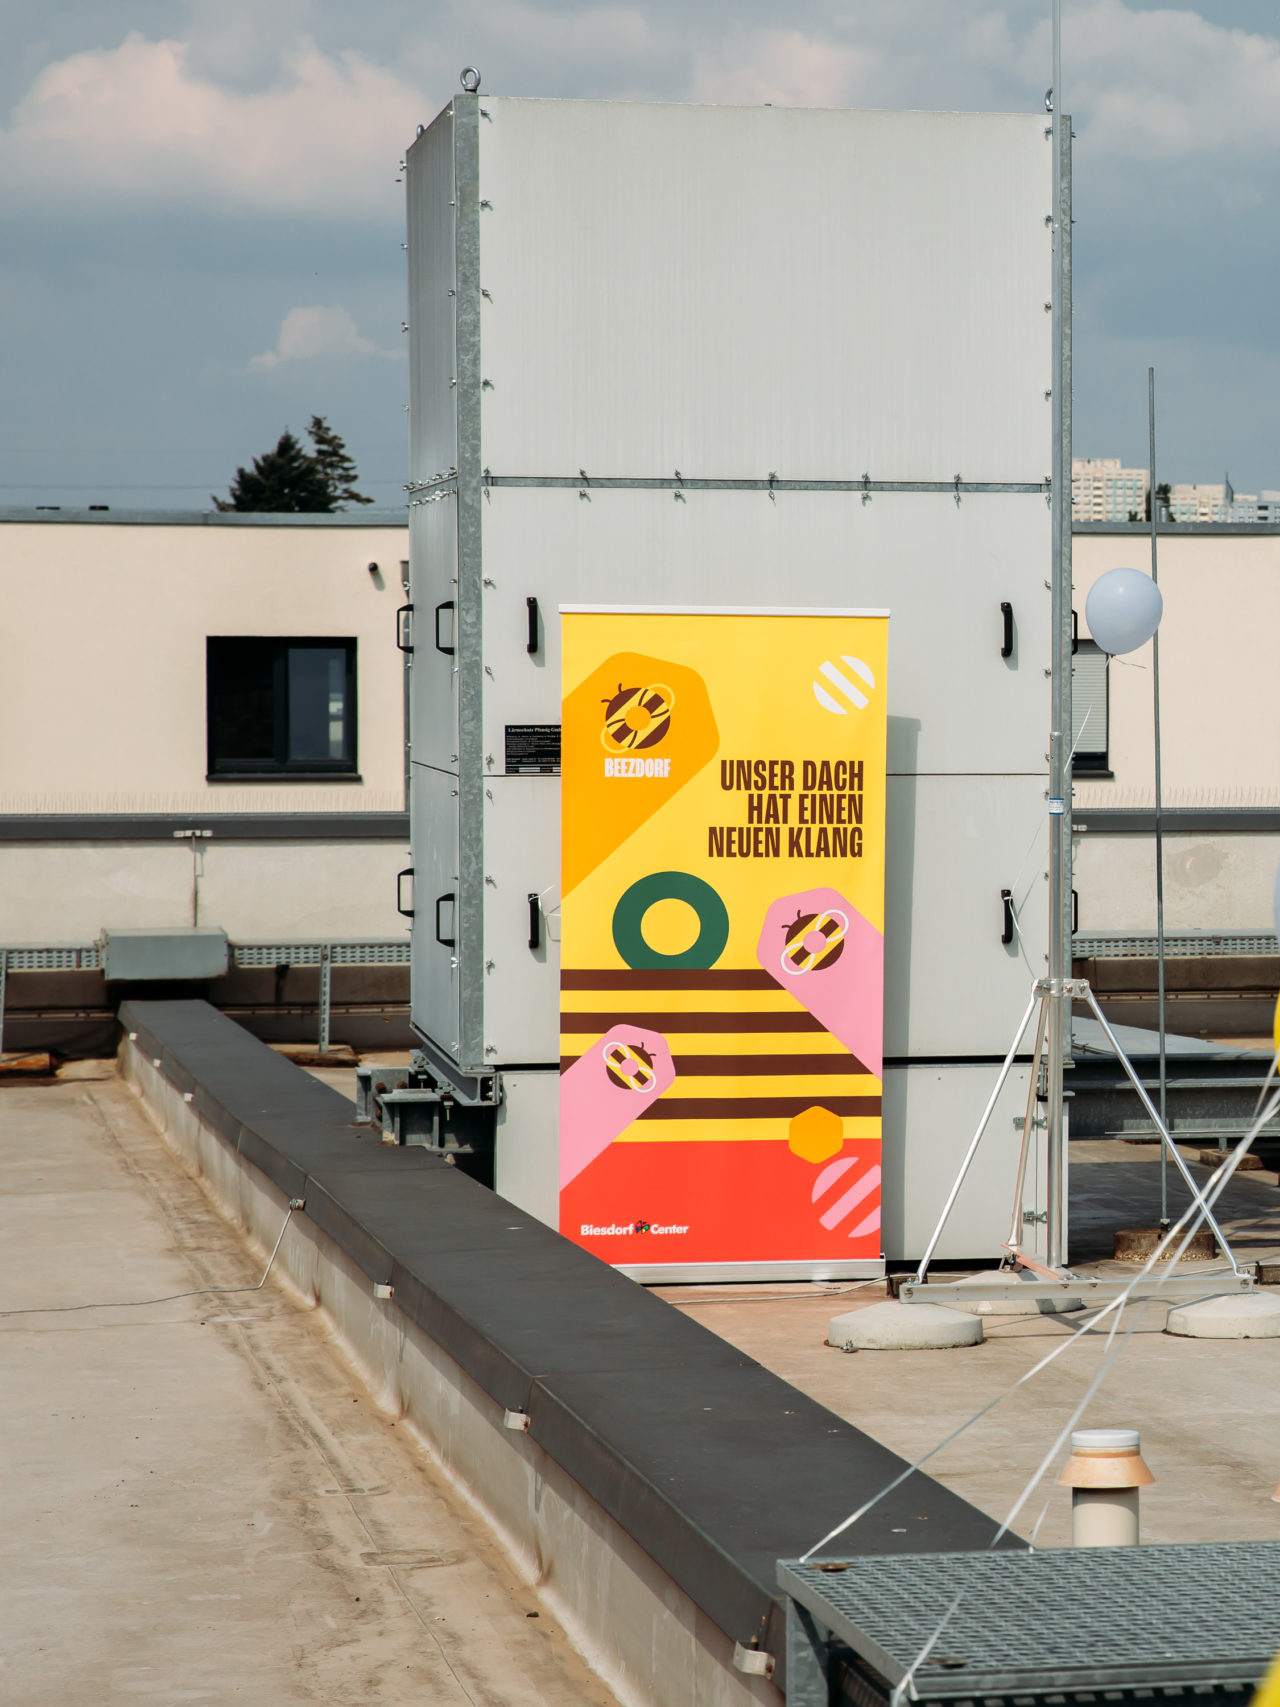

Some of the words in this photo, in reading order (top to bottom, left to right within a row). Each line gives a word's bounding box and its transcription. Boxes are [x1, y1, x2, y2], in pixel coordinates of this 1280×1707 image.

[604, 758, 672, 778] BEEZDORF
[721, 759, 795, 791] UNSER
[802, 760, 864, 791] DACH
[748, 793, 792, 824] HAT
[799, 793, 863, 824] EINEN
[708, 826, 781, 858] NEUEN
[788, 826, 863, 858] KLANG
[580, 1223, 634, 1236] Biesdorf
[650, 1224, 689, 1235] Center
